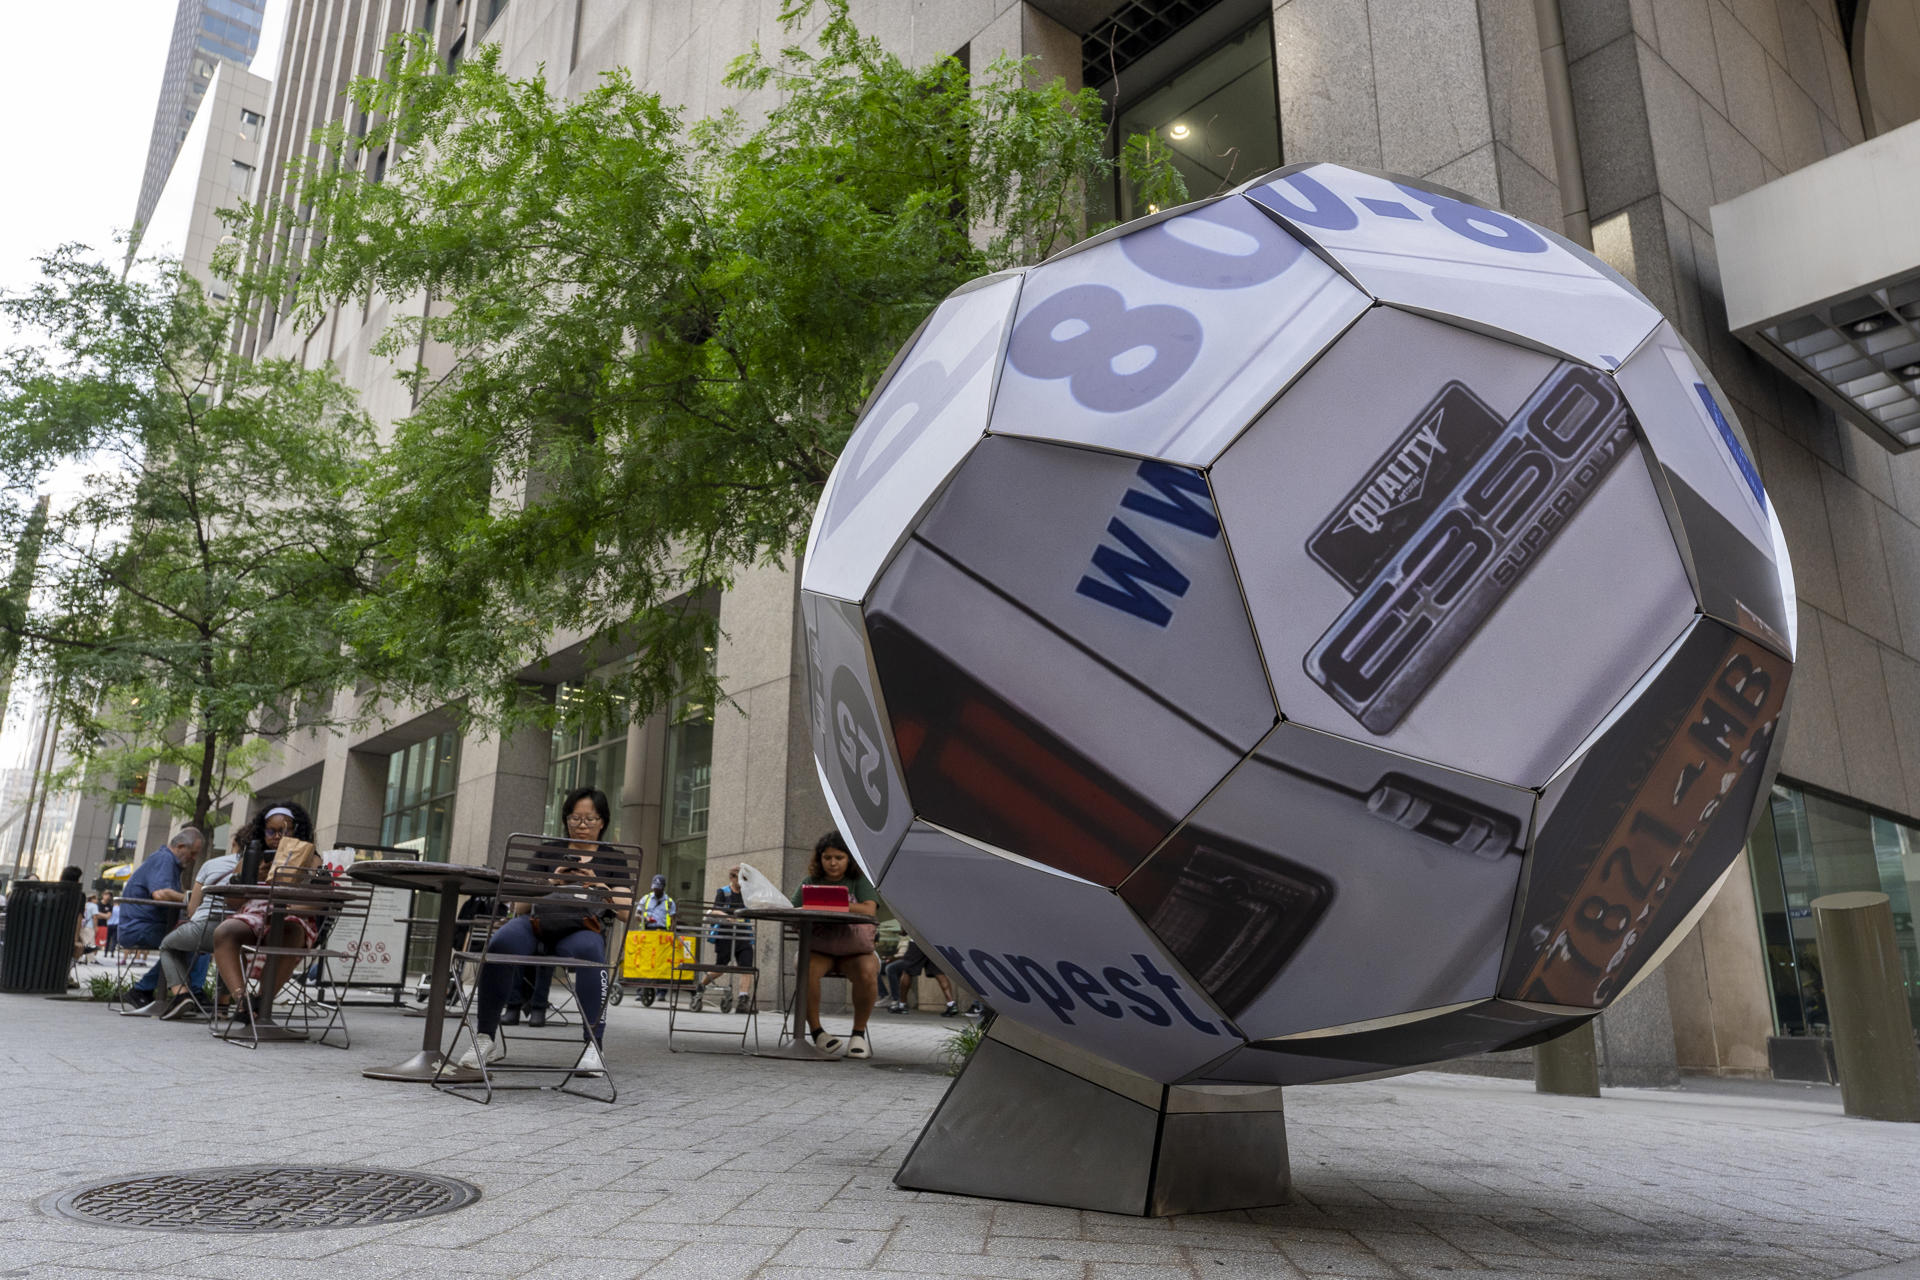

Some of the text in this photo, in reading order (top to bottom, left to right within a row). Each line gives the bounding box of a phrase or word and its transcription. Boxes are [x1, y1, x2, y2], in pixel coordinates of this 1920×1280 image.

[1348, 424, 1448, 534] QUALITY
[1491, 488, 1577, 586] SUPER
[836, 700, 882, 807] 25
